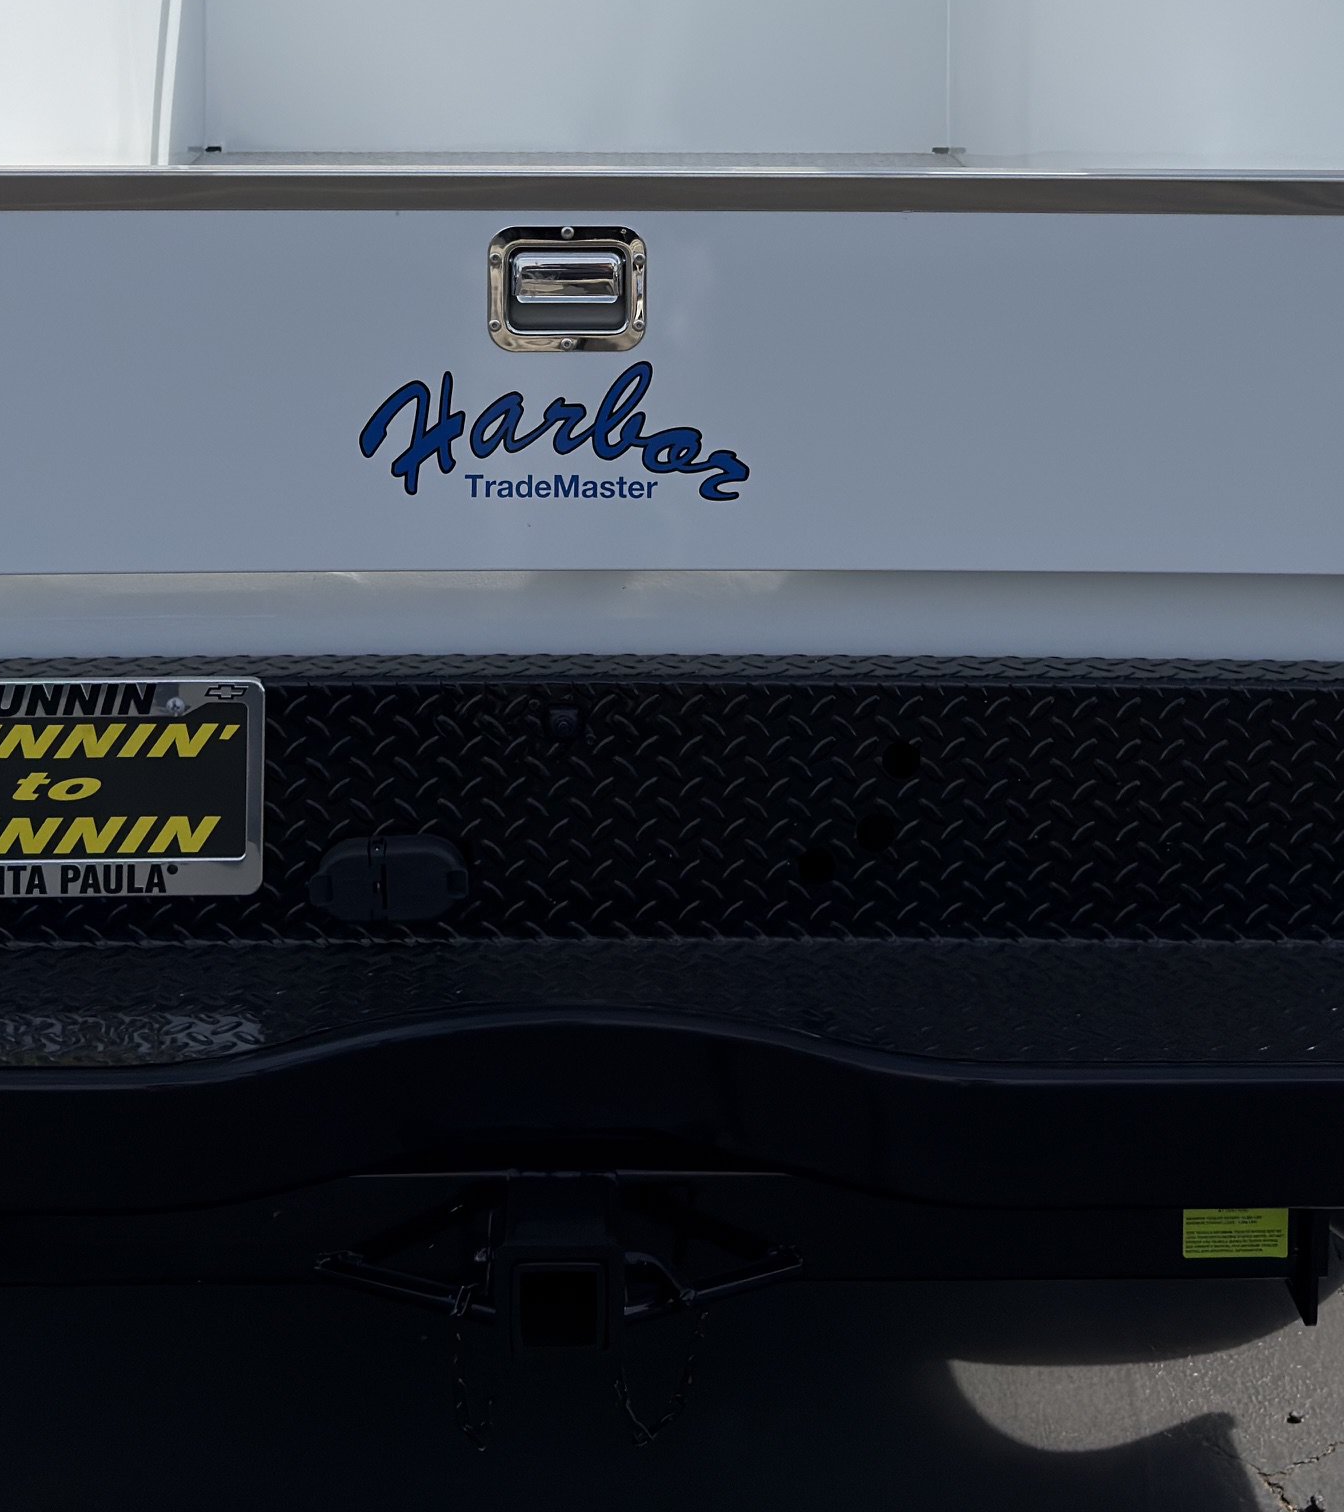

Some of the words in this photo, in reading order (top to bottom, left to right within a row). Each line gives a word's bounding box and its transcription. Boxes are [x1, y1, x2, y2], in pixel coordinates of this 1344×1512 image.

[359, 360, 750, 501] Harbor
[464, 474, 659, 500] TradeMaster
[12, 772, 102, 802] to
[60, 863, 167, 895] PAULA
